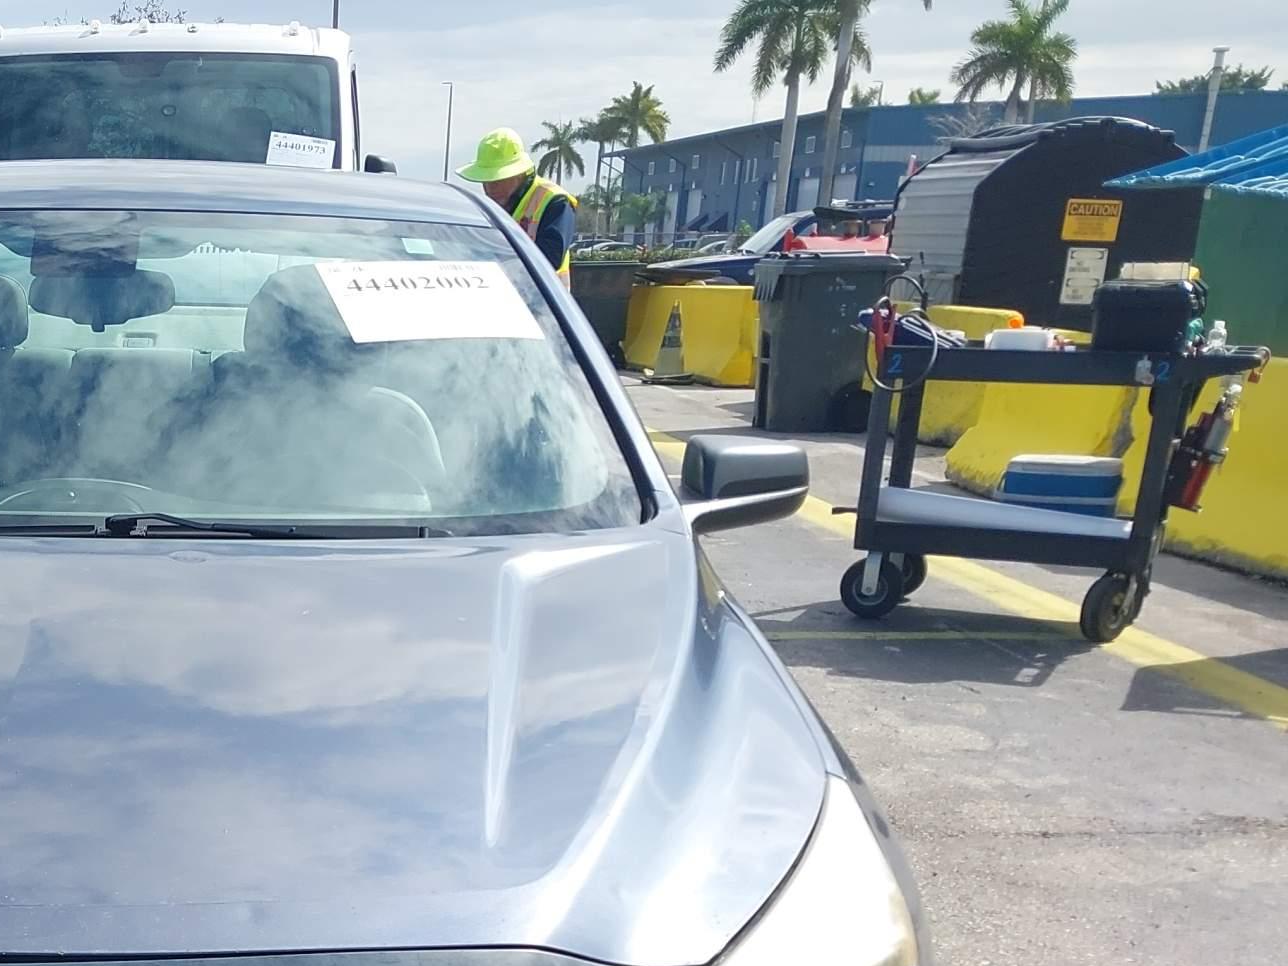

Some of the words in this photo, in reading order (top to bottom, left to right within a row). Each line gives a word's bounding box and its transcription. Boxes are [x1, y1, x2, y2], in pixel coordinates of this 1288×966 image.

[275, 141, 326, 155] 44401973
[1070, 203, 1118, 216] CAUTION
[347, 276, 489, 292] 44402002
[887, 354, 902, 373] 2
[1157, 361, 1170, 381] 2
